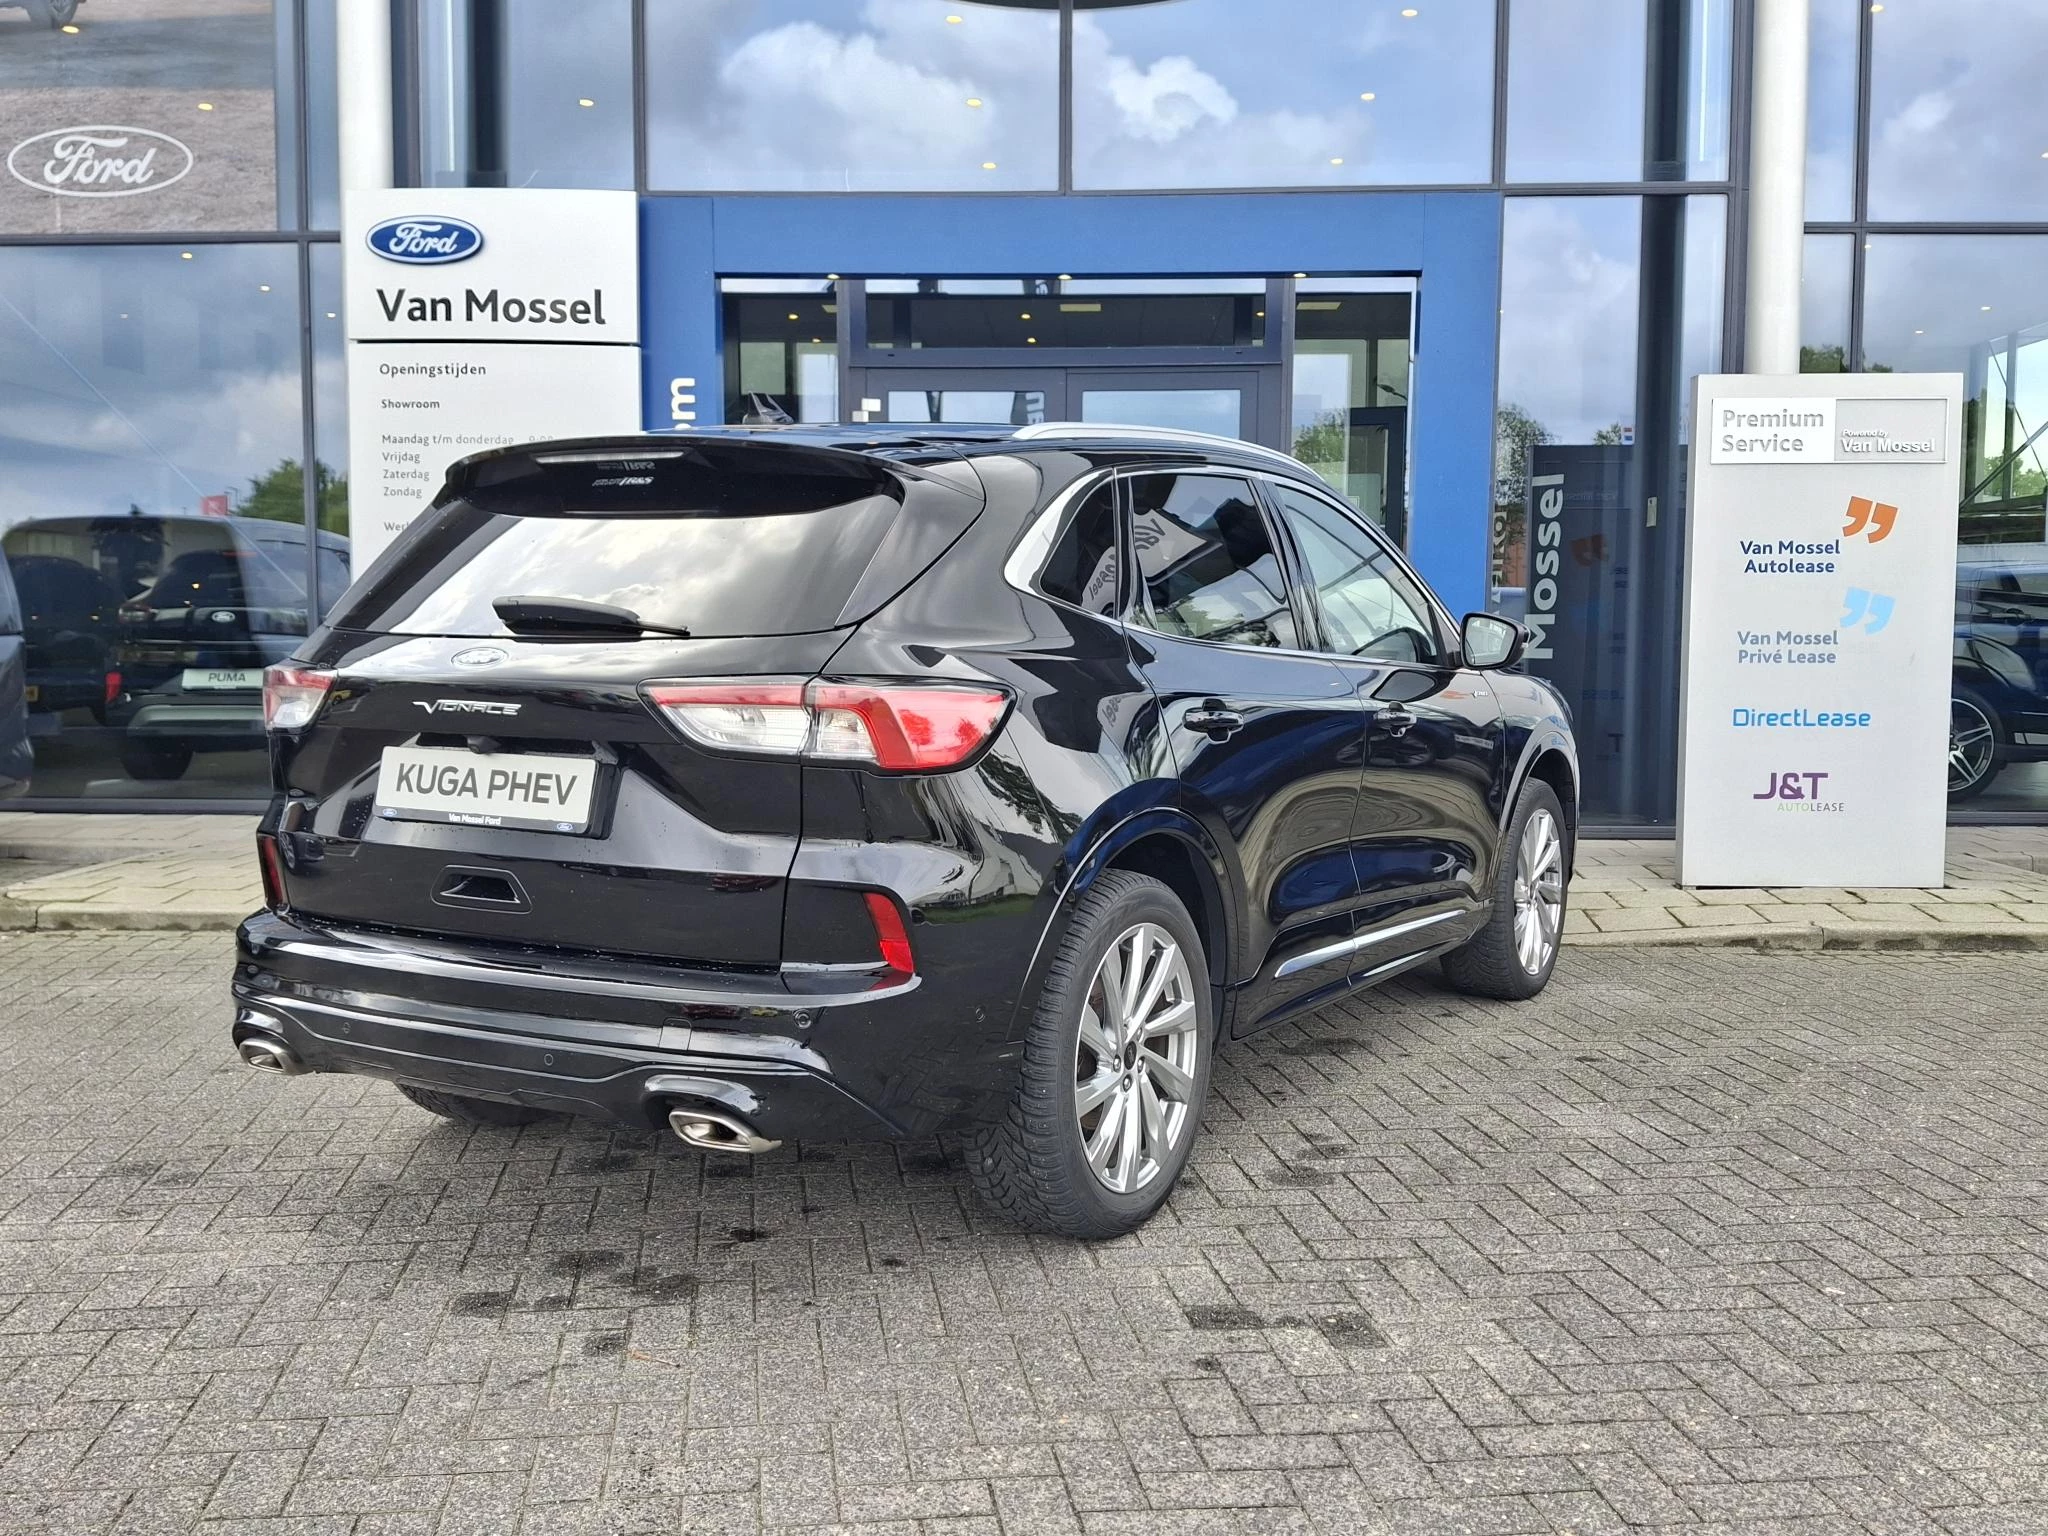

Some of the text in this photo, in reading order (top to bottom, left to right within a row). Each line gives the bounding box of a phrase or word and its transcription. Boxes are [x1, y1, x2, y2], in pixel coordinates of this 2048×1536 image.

[44, 135, 157, 184] Ford
[389, 222, 459, 253] Ford
[376, 288, 606, 325] Van Mossel
[379, 362, 487, 378] Openingstijden
[381, 398, 440, 409] Showroom
[1722, 409, 1824, 428] Premium
[382, 434, 430, 446] Maandag
[433, 435, 453, 444] t/m
[456, 435, 514, 446] donderdag
[1721, 433, 1804, 452] Service
[1841, 438, 1936, 453] Van Mossel
[382, 451, 421, 464] Vrijdag
[383, 468, 430, 482] Zaterdag
[383, 486, 423, 499] Zondag
[1740, 539, 1840, 555] Van Mossel
[1523, 474, 1565, 660] Mossel
[1744, 558, 1835, 573] Autolease
[1737, 630, 1838, 645] Van Mossel
[1738, 649, 1837, 664] Privé Lease
[208, 672, 246, 682] PUMA
[1732, 708, 1871, 727] DirectLease
[396, 762, 578, 806] KUGA PHEV
[1753, 772, 1829, 800] J&T
[1777, 802, 1845, 812] AUTOLEASE
[449, 813, 461, 822] Van
[485, 817, 501, 825] Ford
